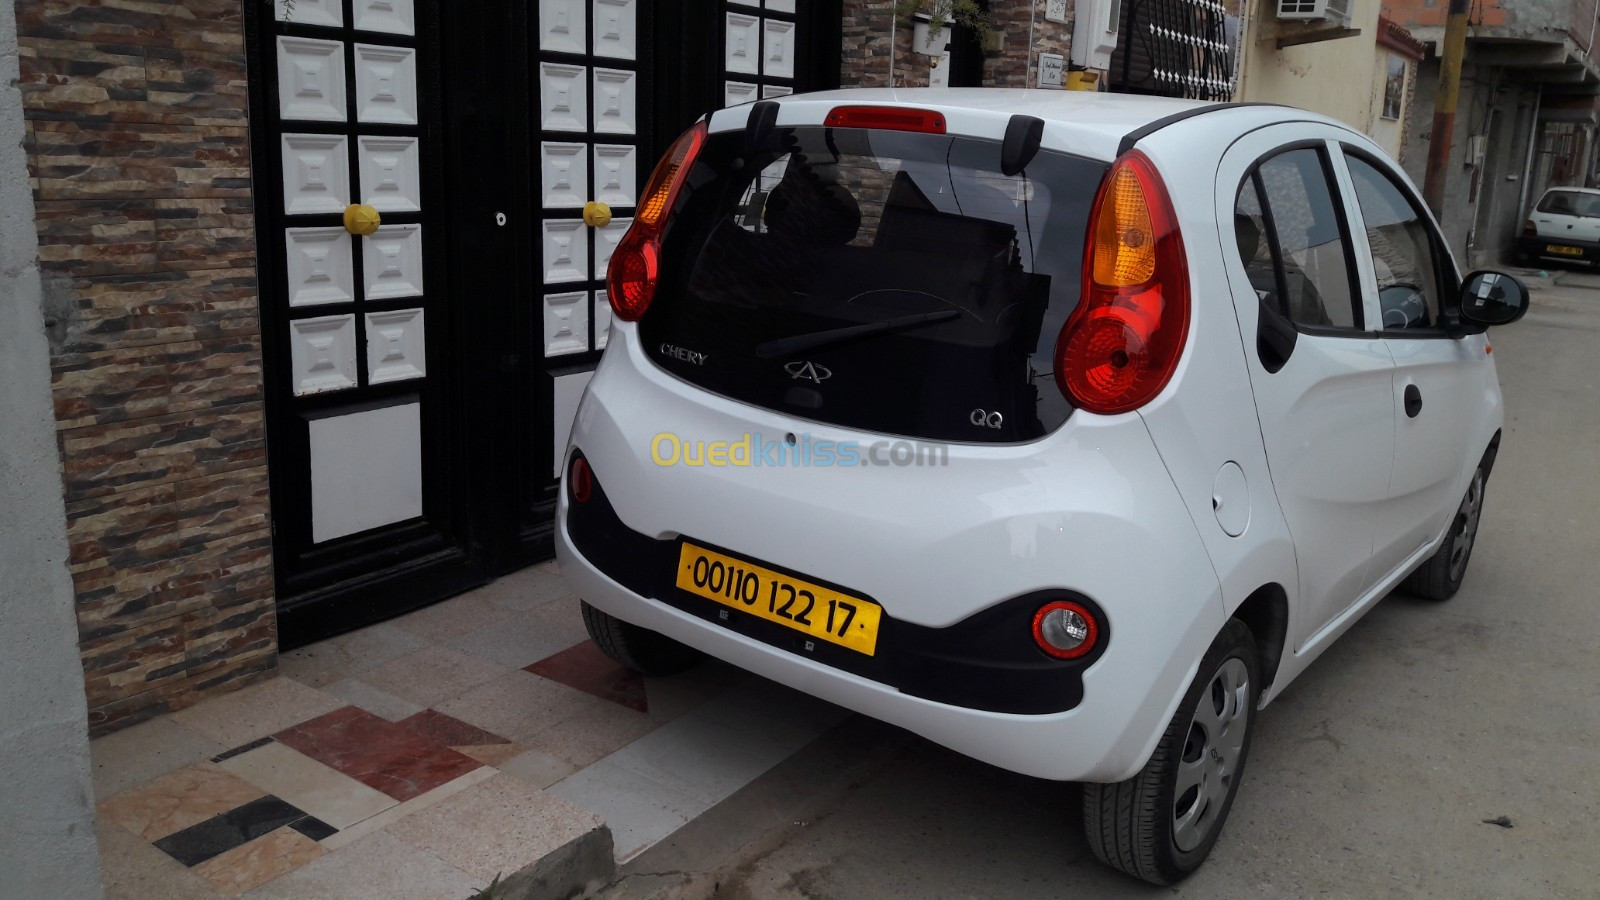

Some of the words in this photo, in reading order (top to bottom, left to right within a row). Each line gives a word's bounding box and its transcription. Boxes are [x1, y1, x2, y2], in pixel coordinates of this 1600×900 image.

[660, 343, 708, 366] CHERY
[970, 408, 1003, 429] QQ
[693, 555, 759, 606] 00110
[769, 580, 815, 627] 122
[826, 599, 857, 638] 17
